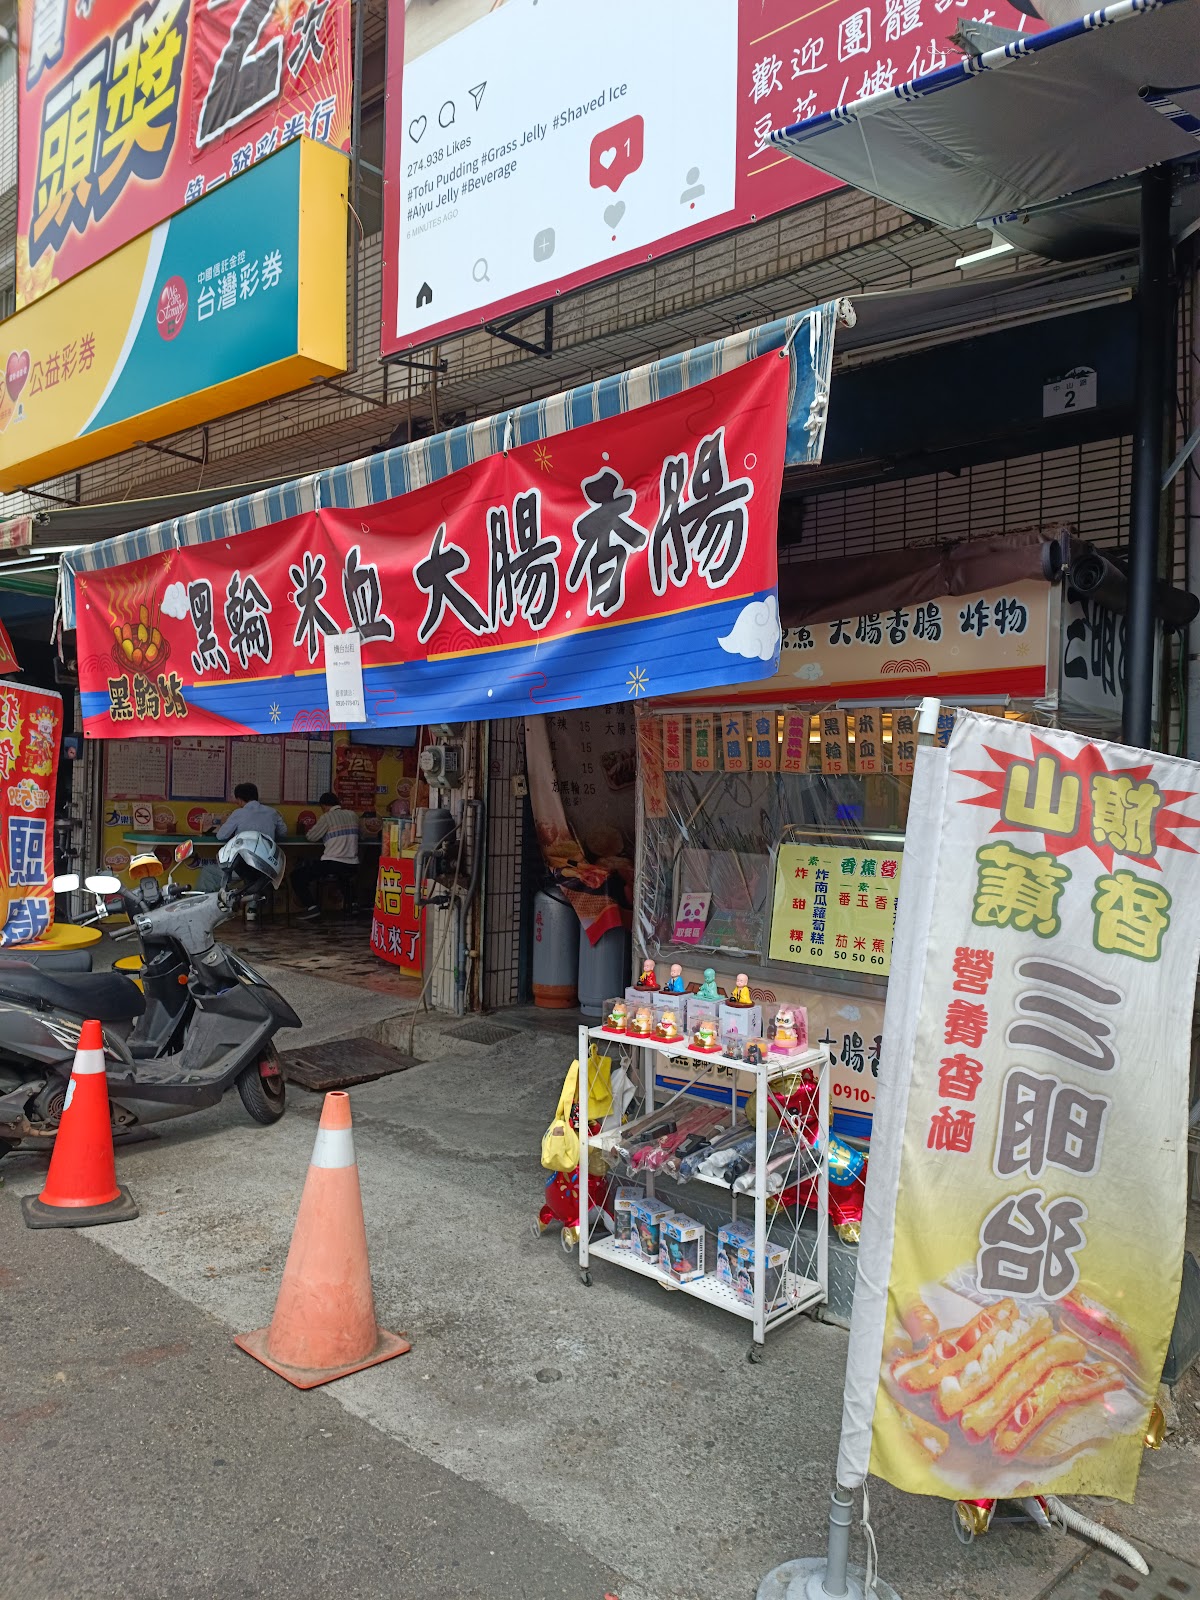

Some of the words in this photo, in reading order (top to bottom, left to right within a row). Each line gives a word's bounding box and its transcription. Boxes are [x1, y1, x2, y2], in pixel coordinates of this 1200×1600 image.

[749, 0, 968, 104] 歡迎團體
[30, 0, 190, 266] 頭獎
[407, 179, 434, 202] #Tofu
[436, 158, 479, 187] Pudding
[481, 141, 518, 166] #Grass
[520, 123, 547, 147] Jelly
[552, 91, 605, 130] #Shaved
[609, 83, 628, 104] Ice
[624, 138, 631, 158] 1
[407, 148, 444, 178] 274.938
[446, 136, 472, 158] Likes
[407, 199, 433, 222] #Aiyu
[435, 187, 459, 208] Jelly
[461, 159, 517, 195] #Beverage
[406, 231, 411, 240] 6
[411, 216, 442, 237] MINUTES
[442, 209, 459, 225] AGO
[197, 250, 246, 284] 中國信託金控
[197, 249, 283, 321] 台灣彩券
[29, 332, 95, 397] 公益彩券
[1065, 391, 1075, 408] 2
[188, 570, 272, 675] 黑輪
[290, 545, 394, 664] 米血
[412, 426, 755, 644] 大腸香腸
[829, 601, 942, 645] 大腸香腸
[959, 598, 1027, 637] 炸物
[107, 671, 188, 722] 黑輪站
[580, 721, 591, 732] 15
[605, 722, 626, 736] 大腸
[859, 714, 875, 757] 米血
[726, 719, 742, 758] 大腸
[756, 717, 771, 758] 香腸
[823, 717, 842, 759] 黑輪
[897, 715, 914, 760] 魚板
[581, 742, 592, 753] 15
[582, 763, 593, 773] 15
[668, 760, 680, 768] 60
[696, 759, 710, 768] 60
[729, 760, 742, 769] 50
[757, 760, 772, 769] 30
[784, 760, 801, 769] 25
[827, 762, 841, 771] 15
[860, 760, 875, 770] 15
[898, 762, 914, 772] 15
[584, 783, 596, 795] 25
[810, 868, 829, 945] 炸南瓜蘿蔔糕
[789, 945, 802, 954] 60
[810, 947, 823, 957] 60
[834, 951, 847, 960] 50
[852, 953, 866, 963] 50
[870, 956, 884, 965] 60
